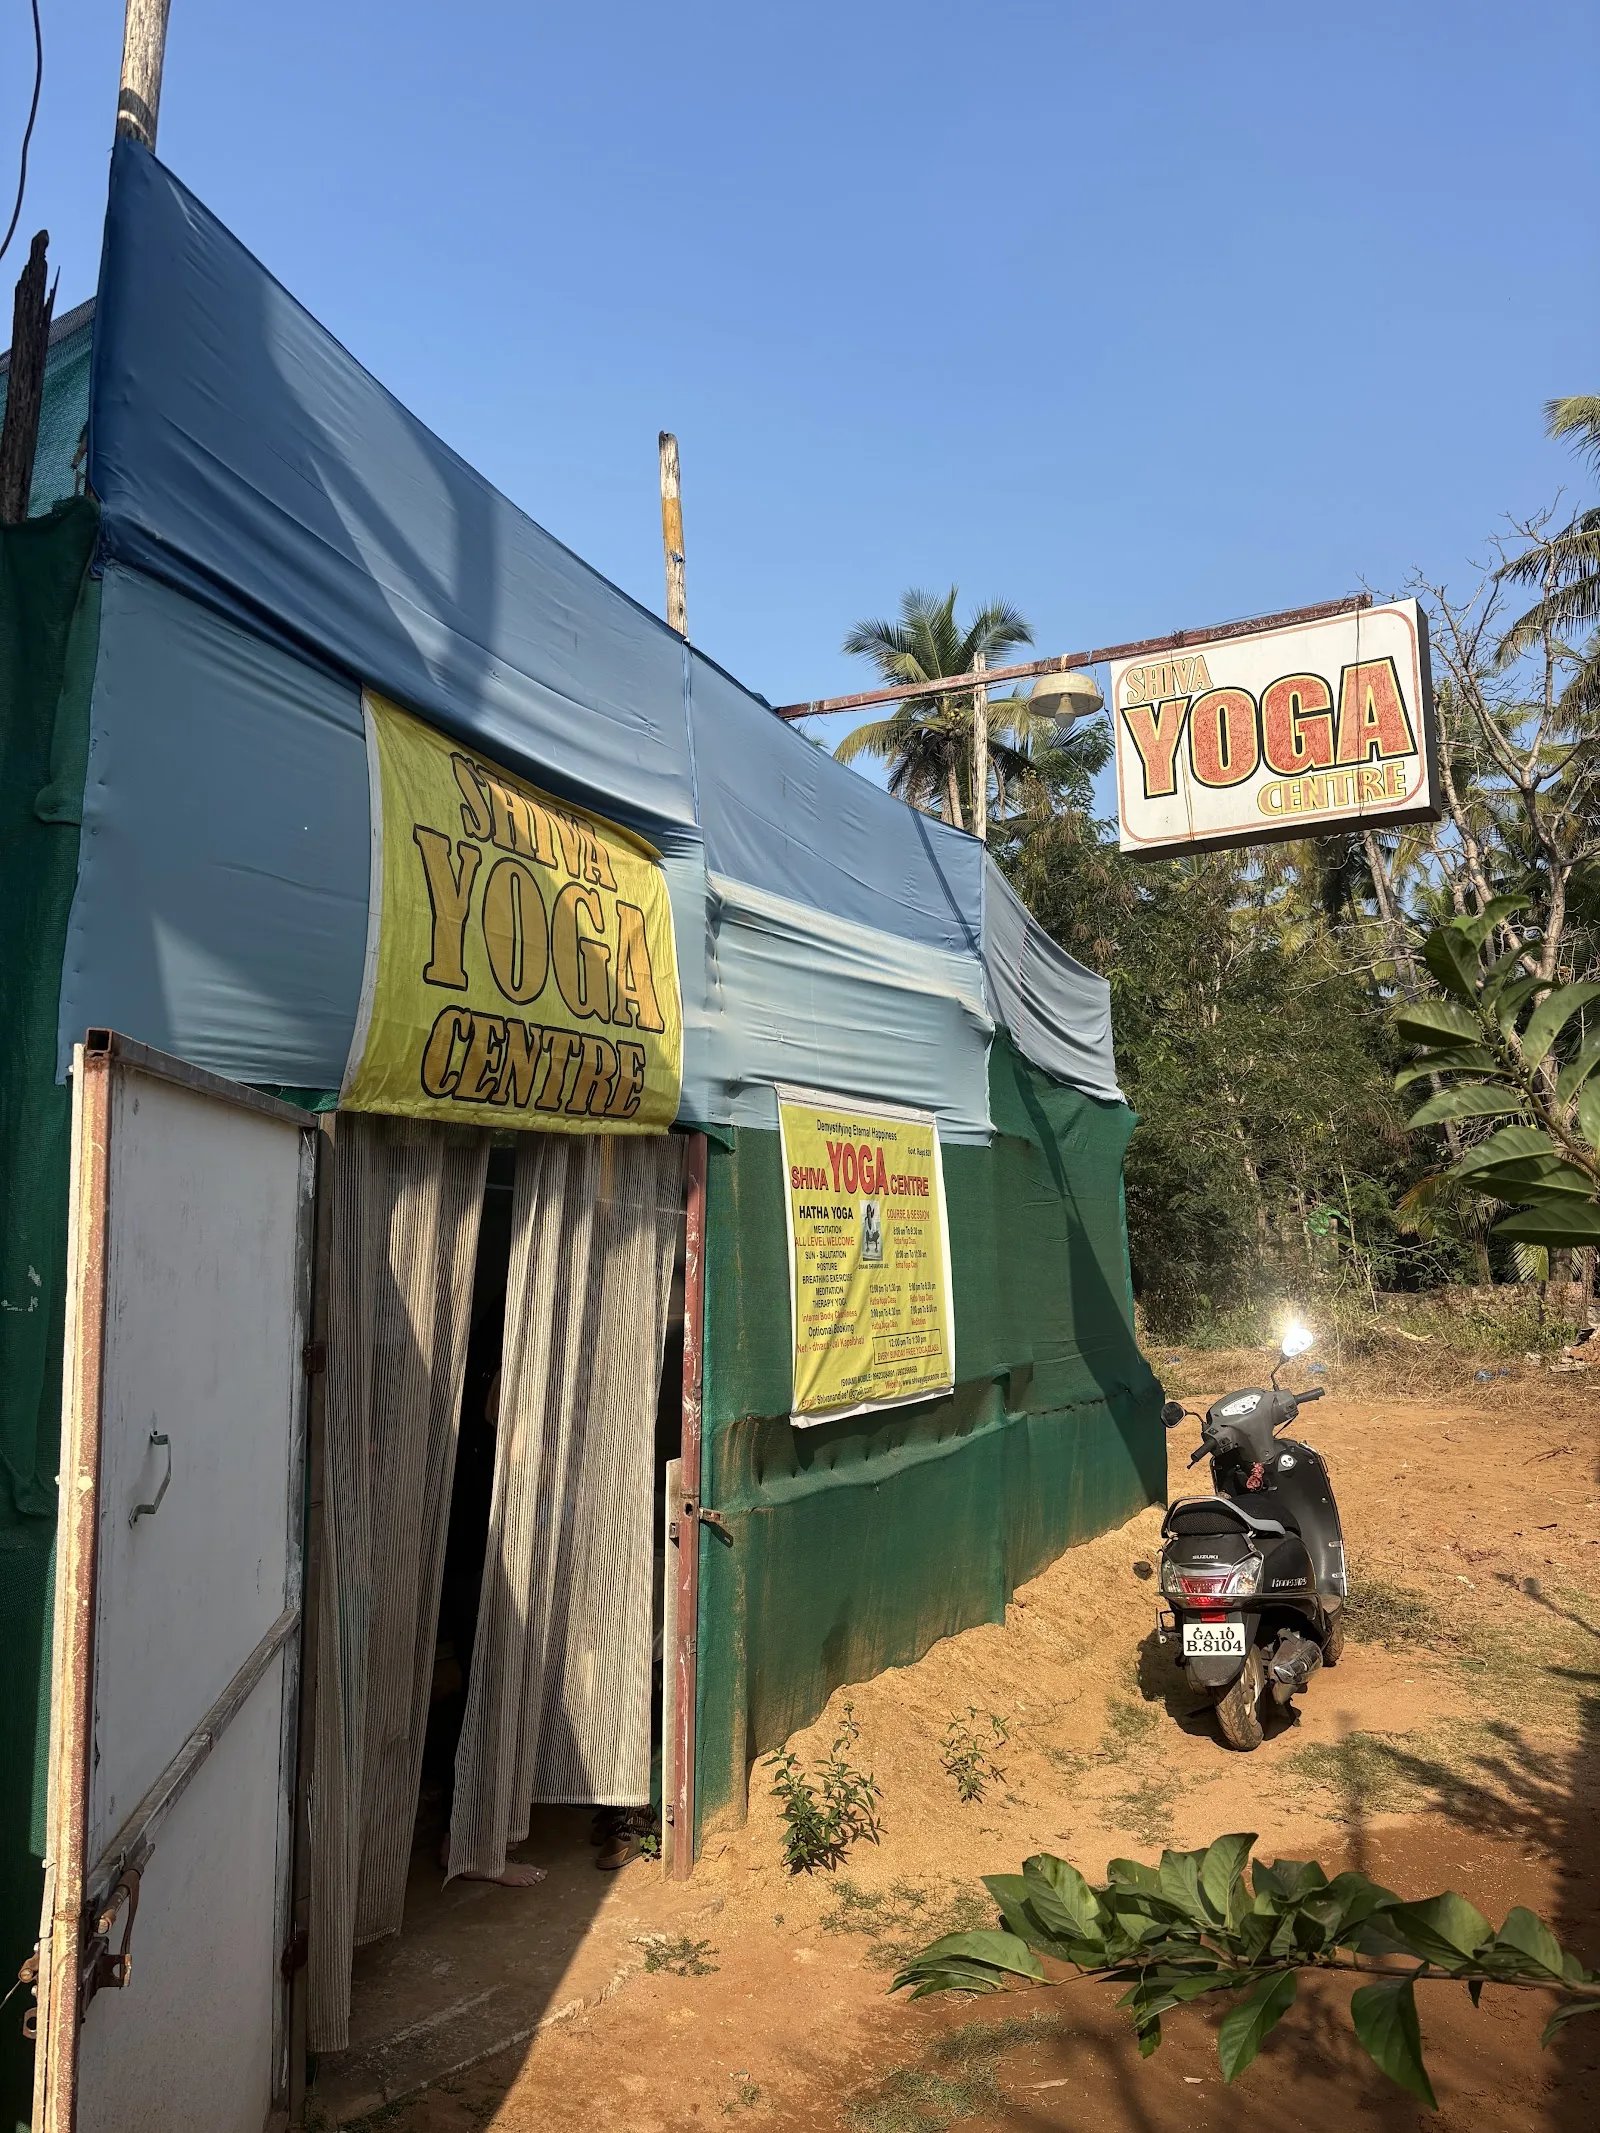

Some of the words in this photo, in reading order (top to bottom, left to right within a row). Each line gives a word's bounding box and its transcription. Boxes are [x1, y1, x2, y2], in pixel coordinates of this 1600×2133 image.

[1126, 655, 1213, 704] SHIVA
[1120, 656, 1418, 800] YOGA
[1257, 761, 1406, 816] CENTRE
[450, 751, 617, 893] SHIVA
[413, 824, 665, 1034] YOGA
[421, 1004, 646, 1119] CENTRE
[817, 1119, 852, 1137] Demystifying
[853, 1125, 871, 1137] Eternal
[871, 1127, 898, 1141] Happiness
[791, 1166, 829, 1190] SHIVA
[826, 1141, 889, 1195] YOGA
[890, 1174, 929, 1196] CENTRE
[799, 1206, 829, 1219] HATHA
[831, 1206, 853, 1219] YOGA
[887, 1209, 906, 1219] COURSE
[910, 1210, 929, 1219] SESSION
[813, 1225, 842, 1234] MEDITATION
[795, 1237, 806, 1247] ALL
[807, 1237, 826, 1247] LEVEL
[827, 1236, 854, 1246] WELCOME
[805, 1251, 815, 1259] SUN
[819, 1250, 846, 1259] SALUTATION
[802, 1275, 829, 1284] BREATHING
[830, 1274, 853, 1282] EXERCISE
[815, 1286, 843, 1296] MEDITATION
[812, 1299, 834, 1308] THERAPY
[820, 1312, 833, 1321] Body
[808, 1325, 833, 1339] Optional
[834, 1322, 854, 1334] Booking
[906, 1348, 916, 1356] FREE
[1193, 1630, 1235, 1640] GA.10
[1186, 1640, 1243, 1652] B.8104
